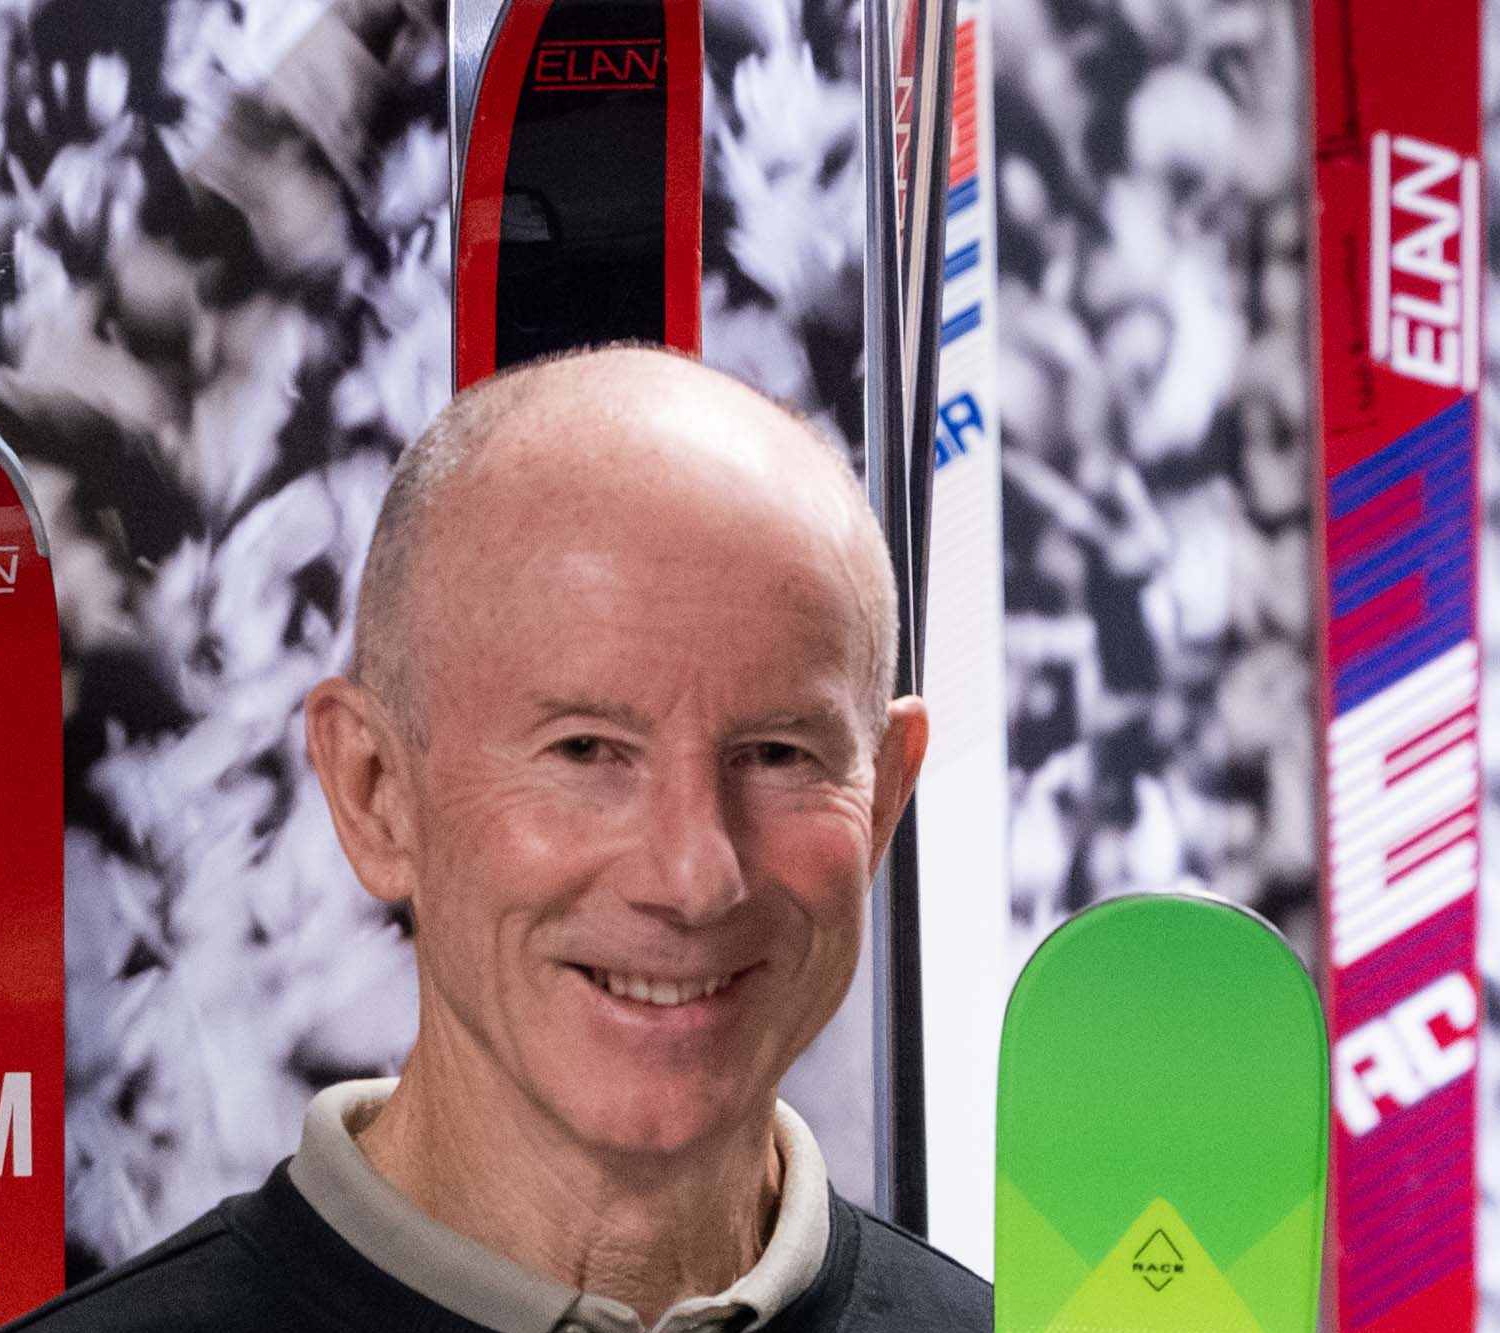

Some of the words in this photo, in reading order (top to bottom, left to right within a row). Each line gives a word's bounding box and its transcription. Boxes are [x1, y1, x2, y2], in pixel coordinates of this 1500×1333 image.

[535, 49, 660, 81] ELAN
[1391, 136, 1462, 386] ELAN
[1334, 970, 1477, 1138] RC
[1132, 1263, 1184, 1273] RACE
